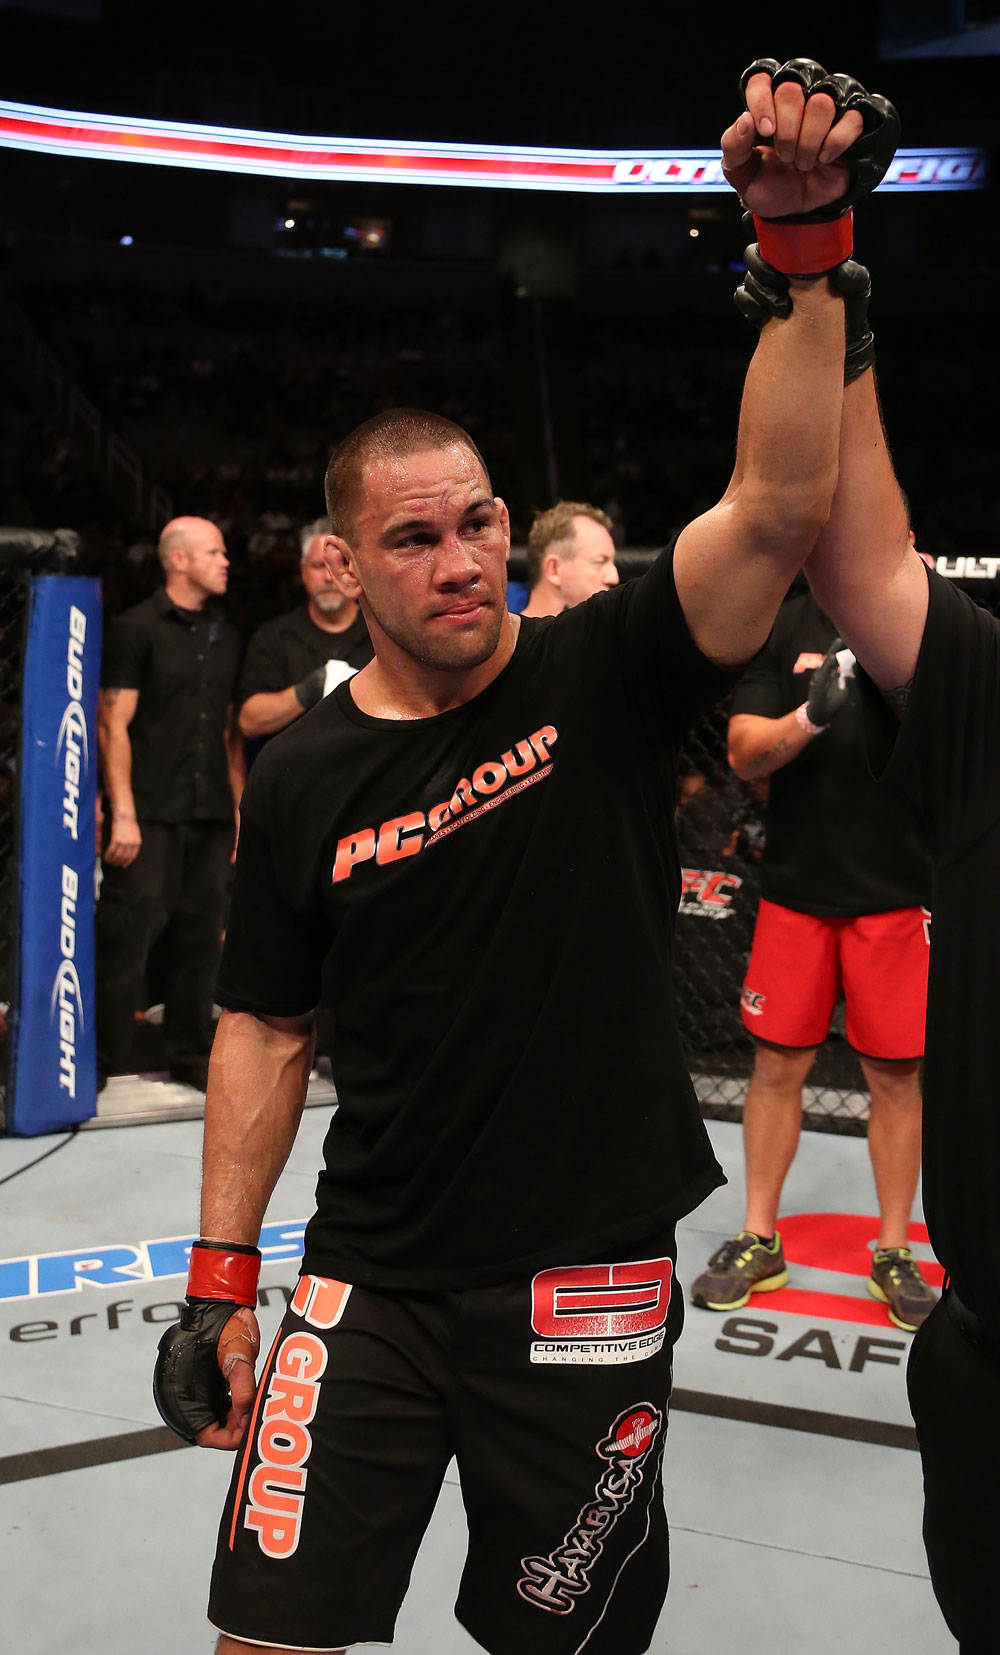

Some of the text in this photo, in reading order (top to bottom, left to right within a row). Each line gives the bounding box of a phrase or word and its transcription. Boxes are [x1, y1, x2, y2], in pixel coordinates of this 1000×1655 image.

[612, 158, 980, 182] ULTI FIG
[936, 556, 1000, 579] ULT
[62, 604, 87, 840] BUD LIGHT
[58, 863, 79, 1099] BUD LIGHT
[532, 1355, 604, 1364] CHANGING
[614, 1354, 637, 1363] THE
[534, 1330, 665, 1353] COMPETITIVE EDGE
[715, 1317, 906, 1373] SAF
[243, 1331, 329, 1559] GROUP
[523, 1452, 645, 1609] HAYABUSA
